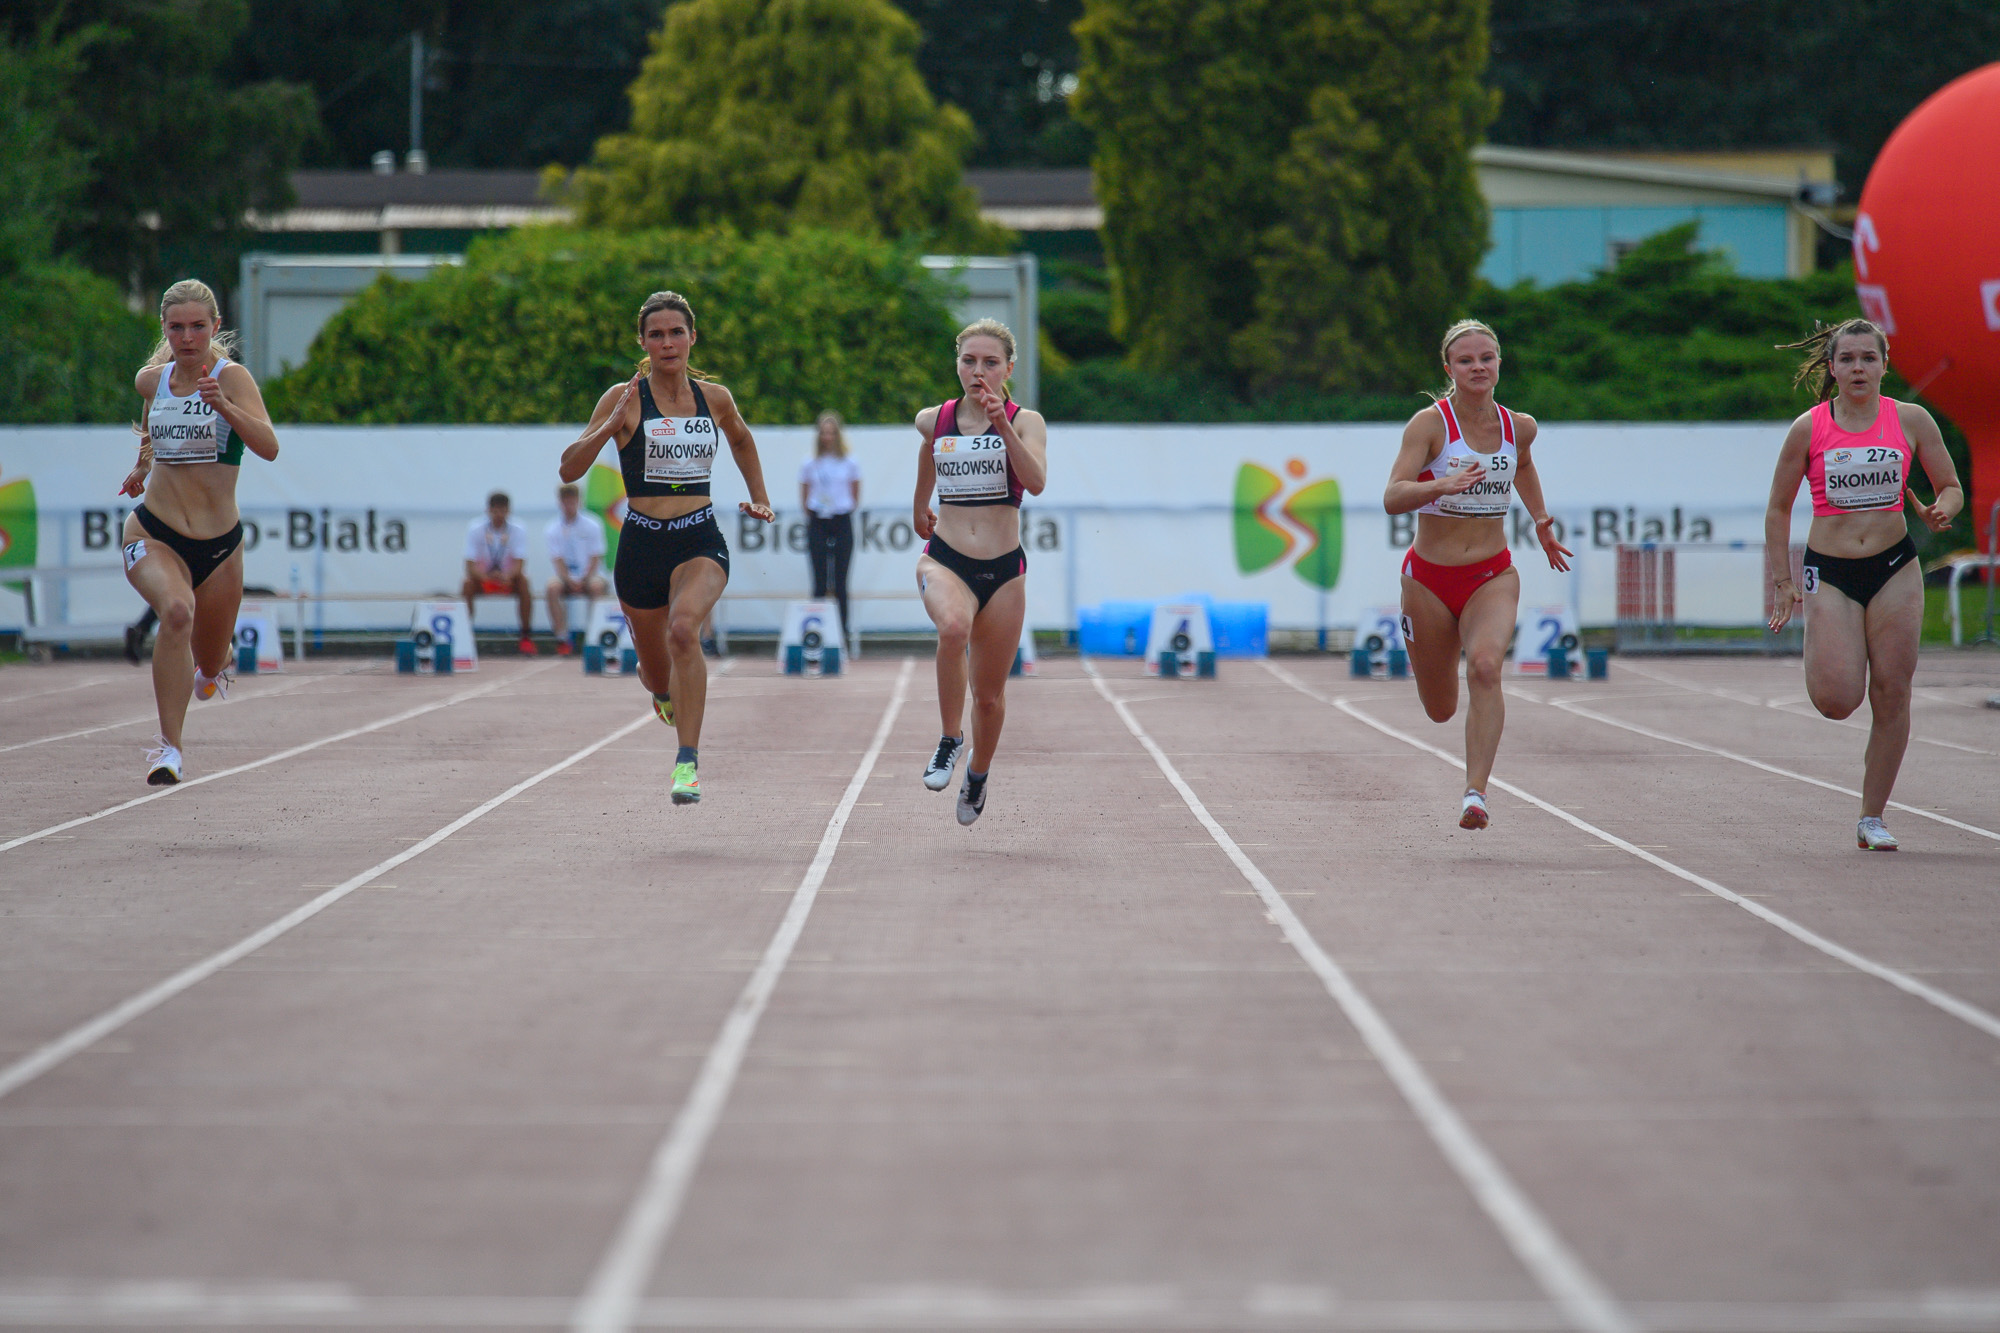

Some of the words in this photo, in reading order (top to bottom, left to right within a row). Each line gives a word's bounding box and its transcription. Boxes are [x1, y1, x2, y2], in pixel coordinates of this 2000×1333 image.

[183, 400, 213, 416] 210
[151, 425, 212, 440] ADAMCZEWSKA
[684, 419, 711, 434] 668
[648, 441, 713, 459] ŻUKOWSKA
[971, 437, 1002, 450] 516
[1491, 456, 1508, 471] 55
[1866, 448, 1899, 463] 274
[936, 460, 1005, 477] KOZŁOWSKA
[1829, 470, 1900, 489] SKOMIAŁ
[628, 512, 662, 530] PRO
[667, 511, 705, 531] NIKE
[126, 543, 138, 561] 7
[1805, 568, 1815, 592] 3
[432, 614, 453, 645] 8
[1401, 616, 1411, 637] 4
[1538, 618, 1562, 654] 2
